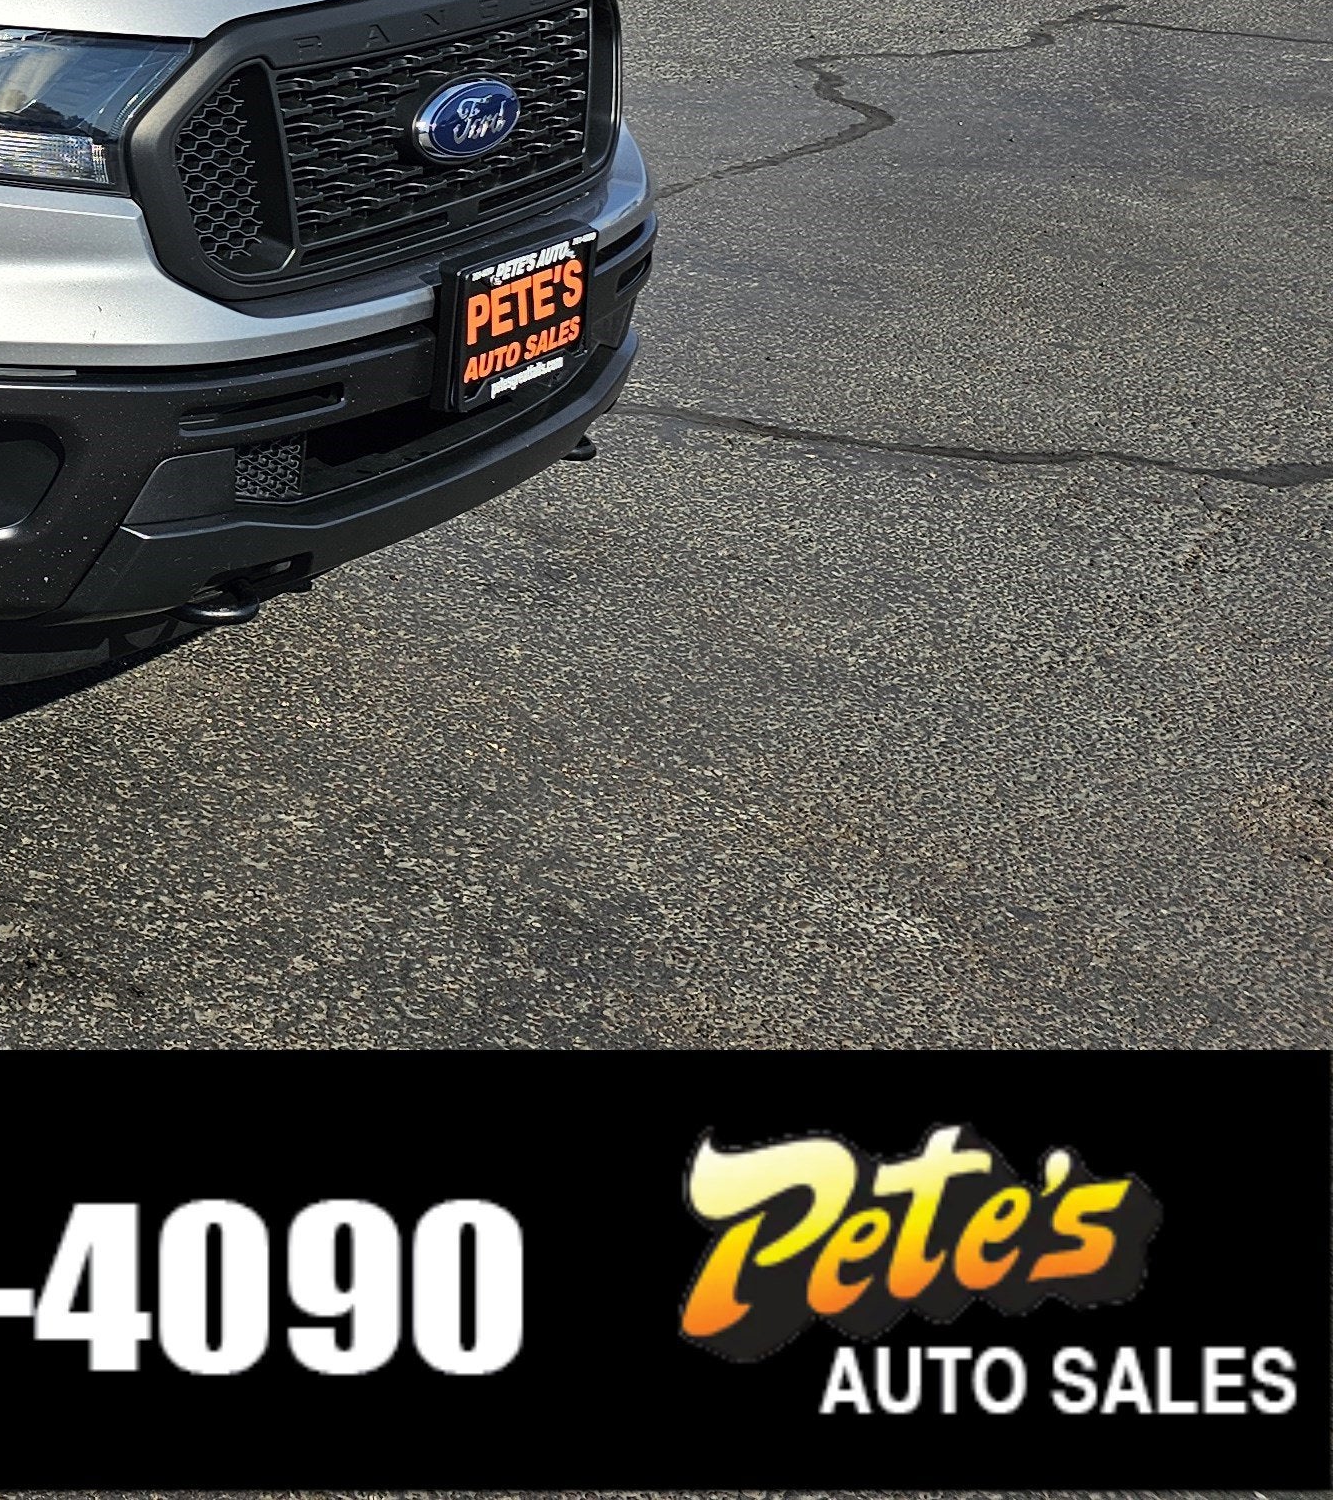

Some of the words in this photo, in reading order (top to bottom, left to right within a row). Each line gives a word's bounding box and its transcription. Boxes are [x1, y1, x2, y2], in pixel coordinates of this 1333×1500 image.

[453, 94, 506, 145] Ford
[536, 241, 570, 268] AUTO
[466, 259, 583, 346] PETE'S
[463, 342, 522, 384] AUTO
[524, 315, 581, 360] SALES
